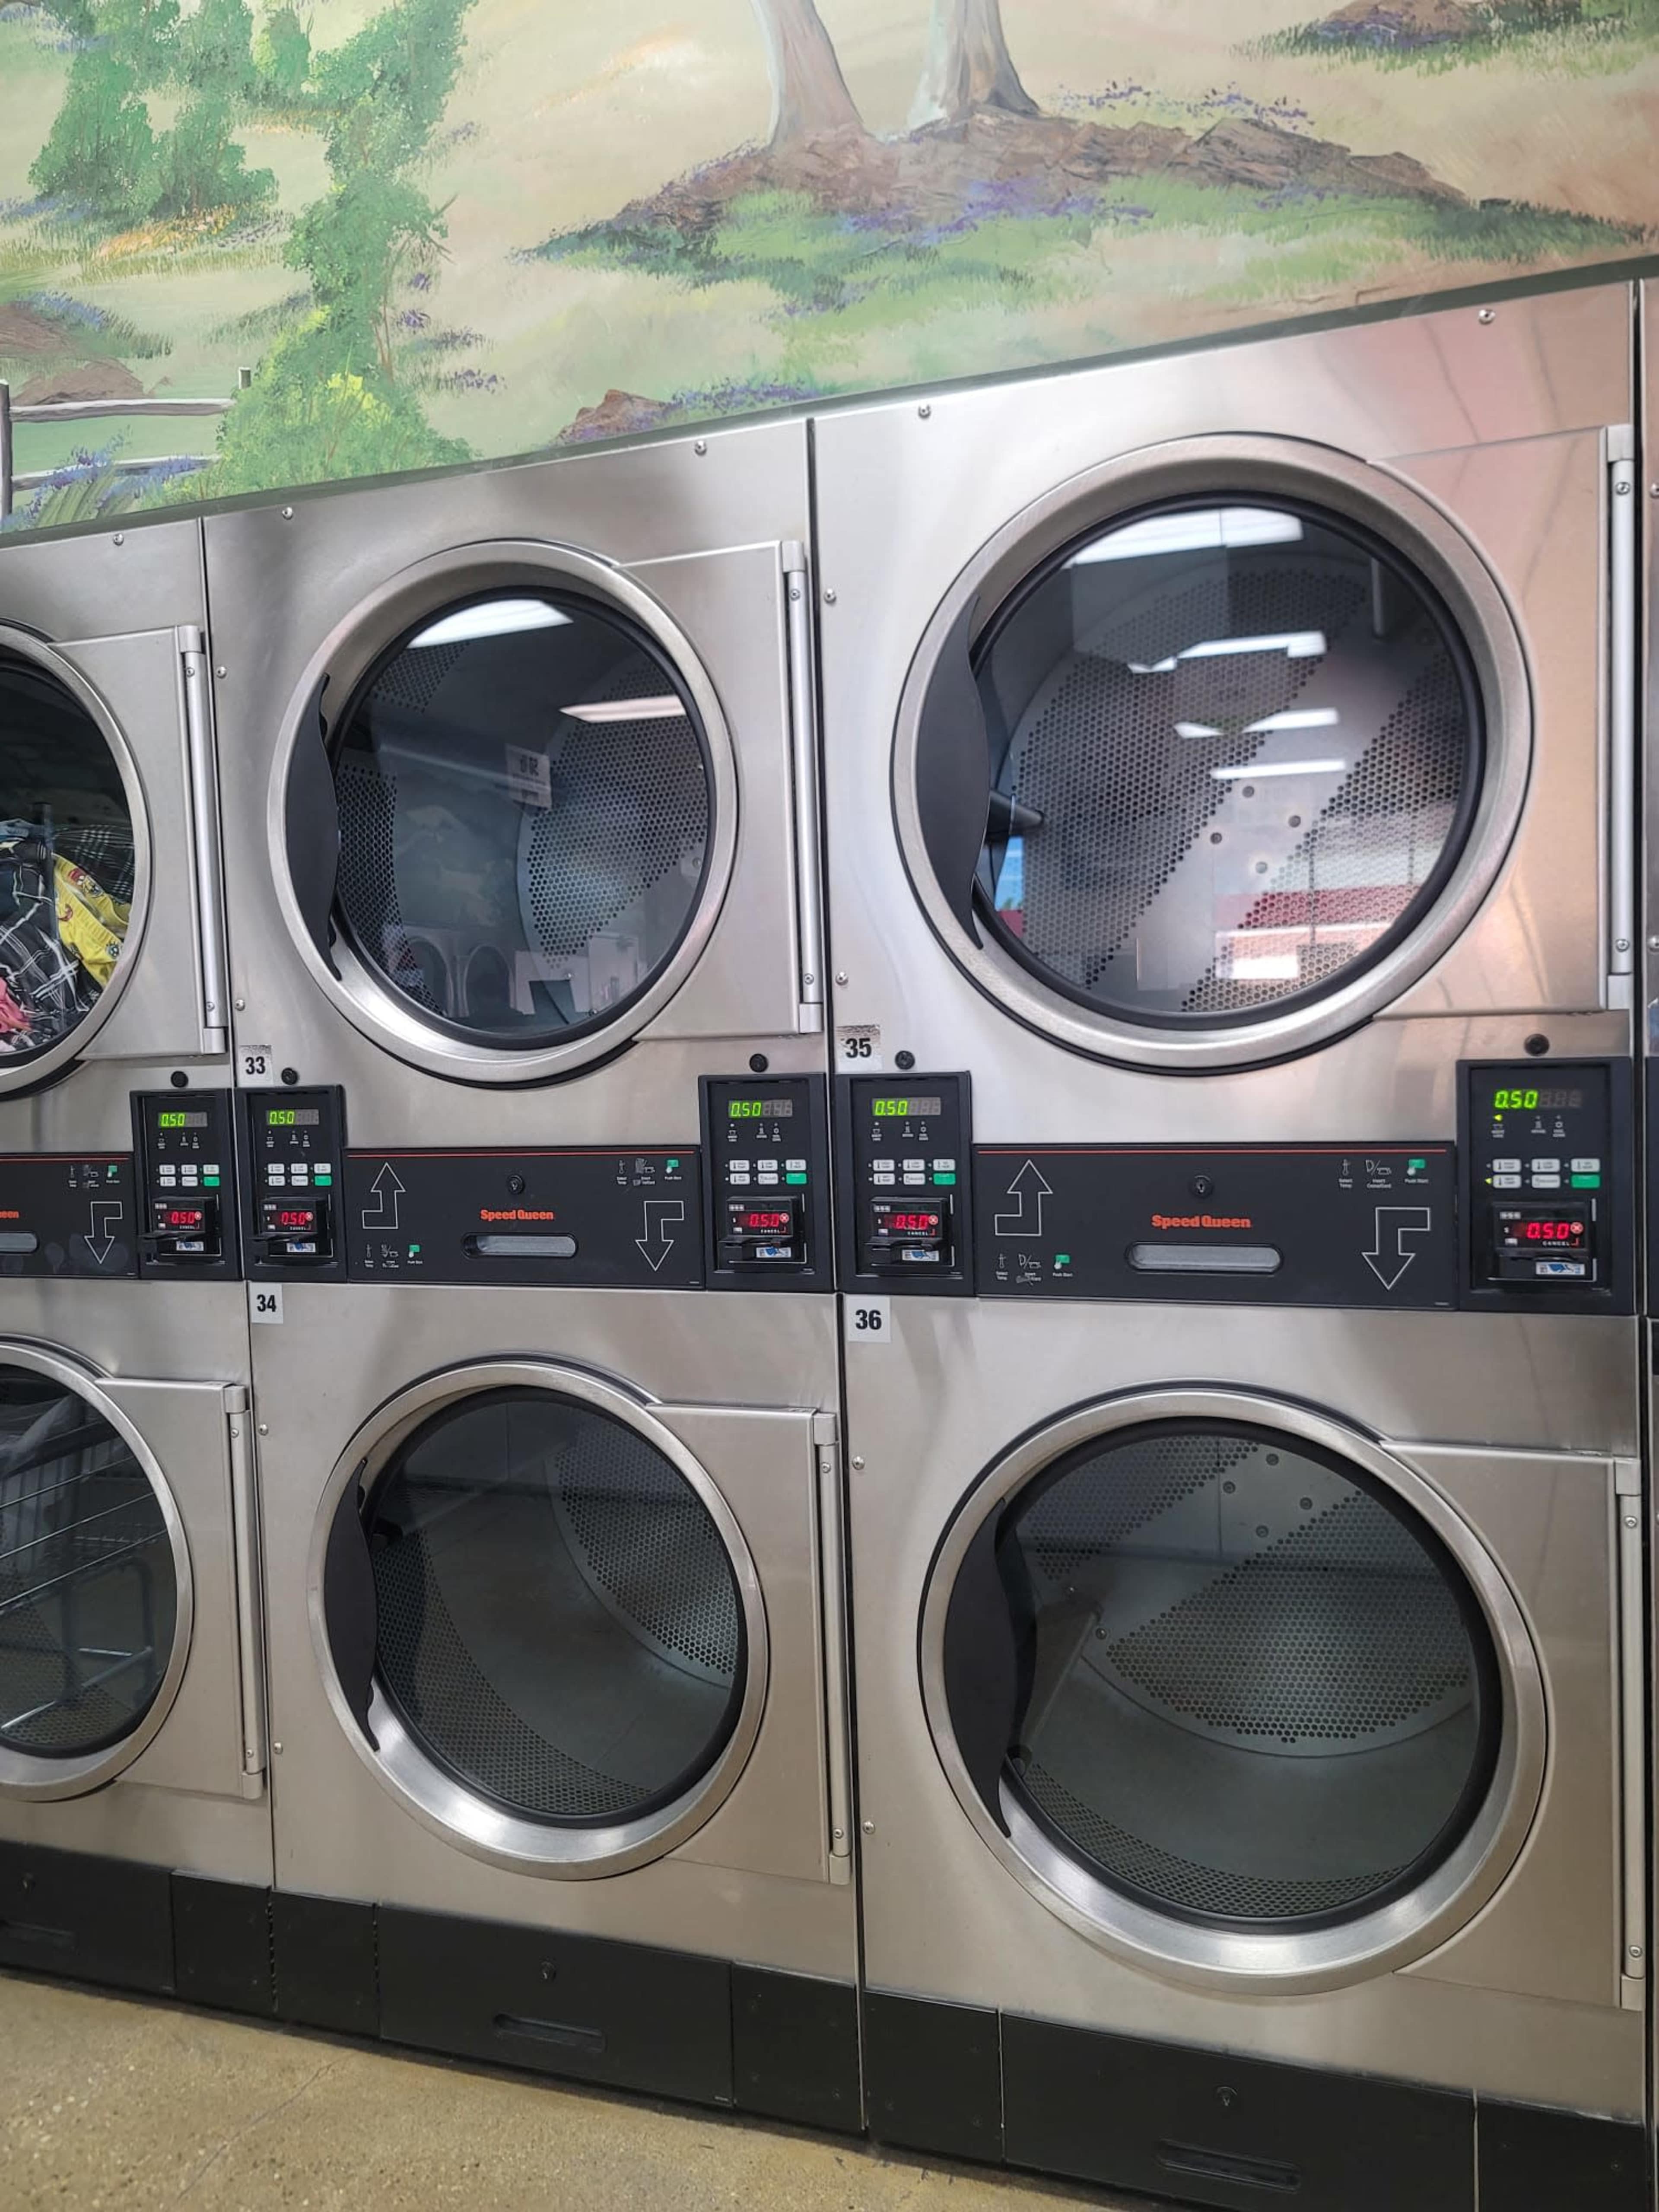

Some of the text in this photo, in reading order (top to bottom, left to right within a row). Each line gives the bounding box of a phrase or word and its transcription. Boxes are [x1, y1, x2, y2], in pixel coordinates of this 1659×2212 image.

[845, 1038, 871, 1058] 35
[245, 1056, 265, 1074] 33
[874, 1100, 908, 1116] 0.50
[1494, 1090, 1538, 1109] 0.50
[731, 1102, 761, 1117] 0.50
[480, 1209, 553, 1221] Speed Queen
[1152, 1215, 1251, 1229] Speed Queen
[1526, 1222, 1570, 1239] 0.50
[257, 1294, 276, 1312] 34
[855, 1309, 882, 1330] 36
